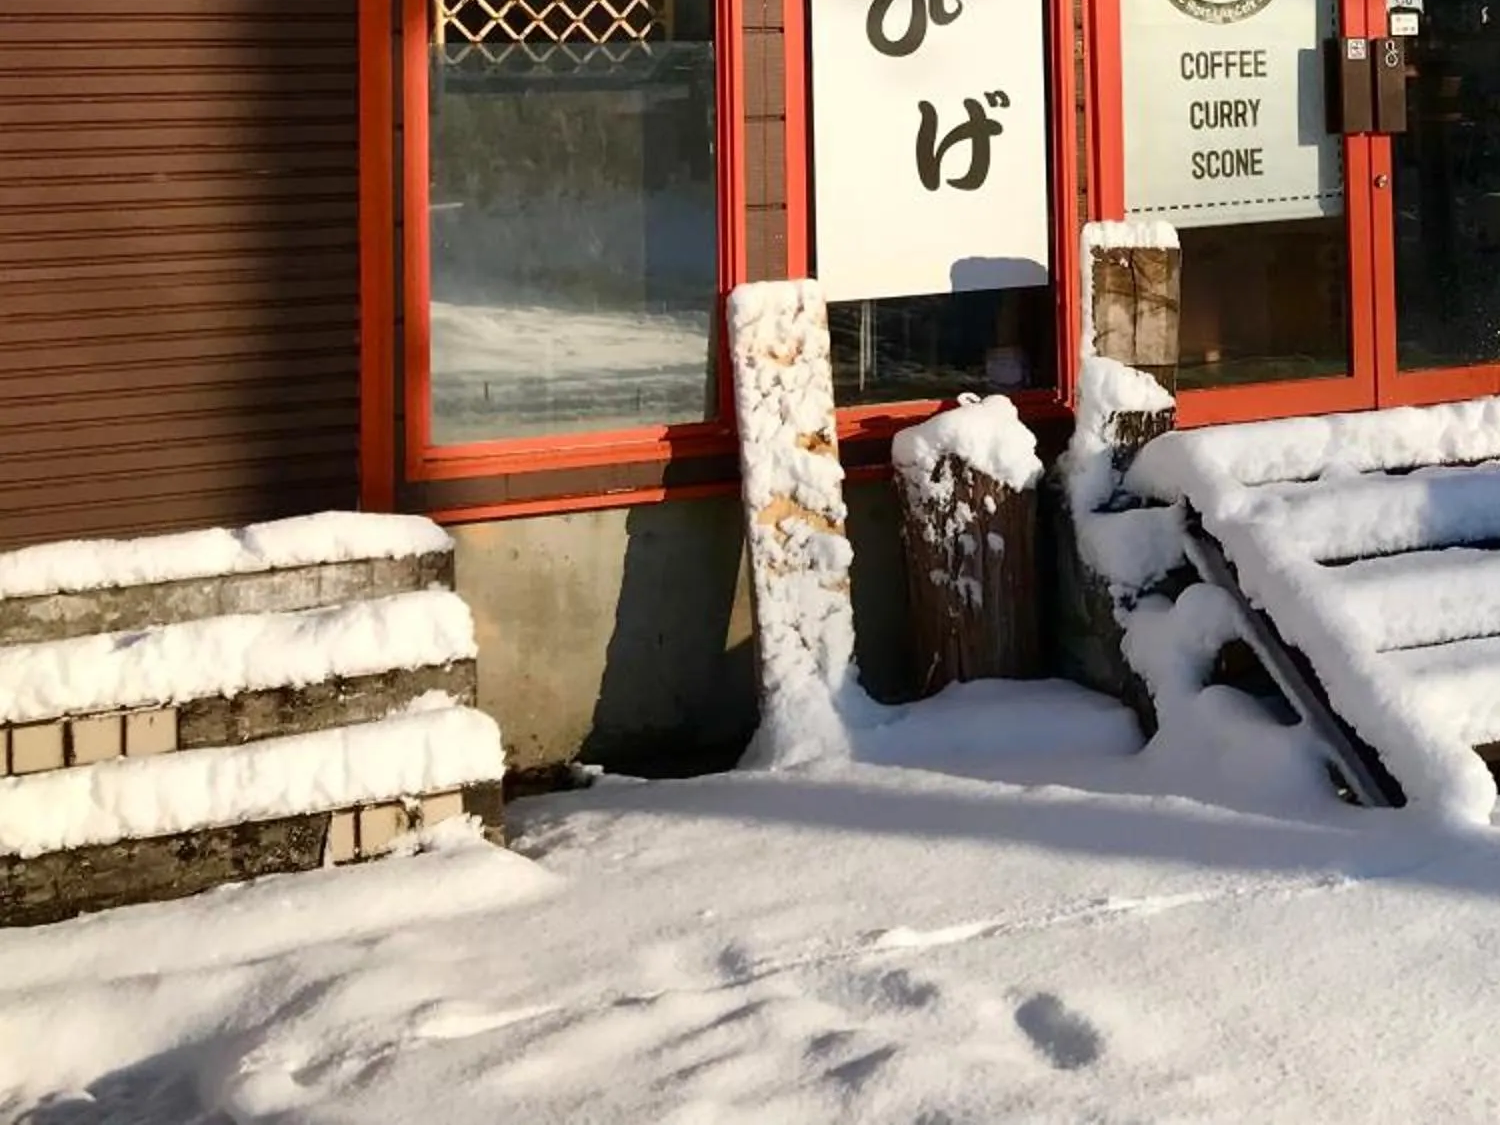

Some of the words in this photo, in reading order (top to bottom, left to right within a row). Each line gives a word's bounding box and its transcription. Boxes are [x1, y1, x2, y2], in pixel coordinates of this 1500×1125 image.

[1180, 49, 1267, 80] COFFEE
[1189, 98, 1261, 130] CURRY
[1191, 147, 1264, 180] SCONE
